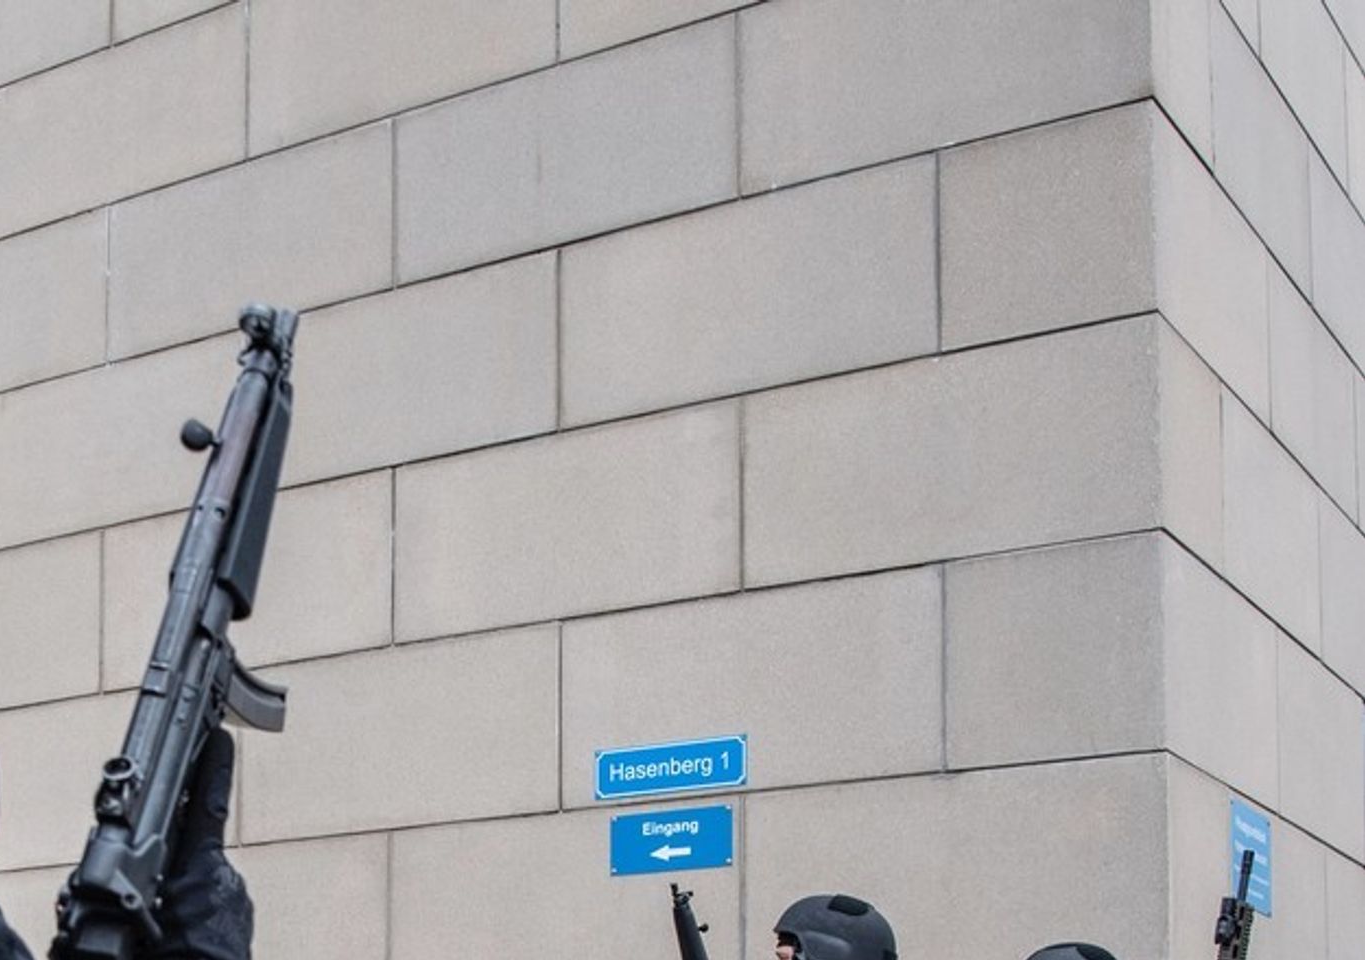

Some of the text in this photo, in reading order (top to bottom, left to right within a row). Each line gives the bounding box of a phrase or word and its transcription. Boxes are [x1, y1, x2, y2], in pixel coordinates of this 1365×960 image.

[609, 751, 730, 782] Hasenberg 1
[642, 821, 699, 837] Eingang
